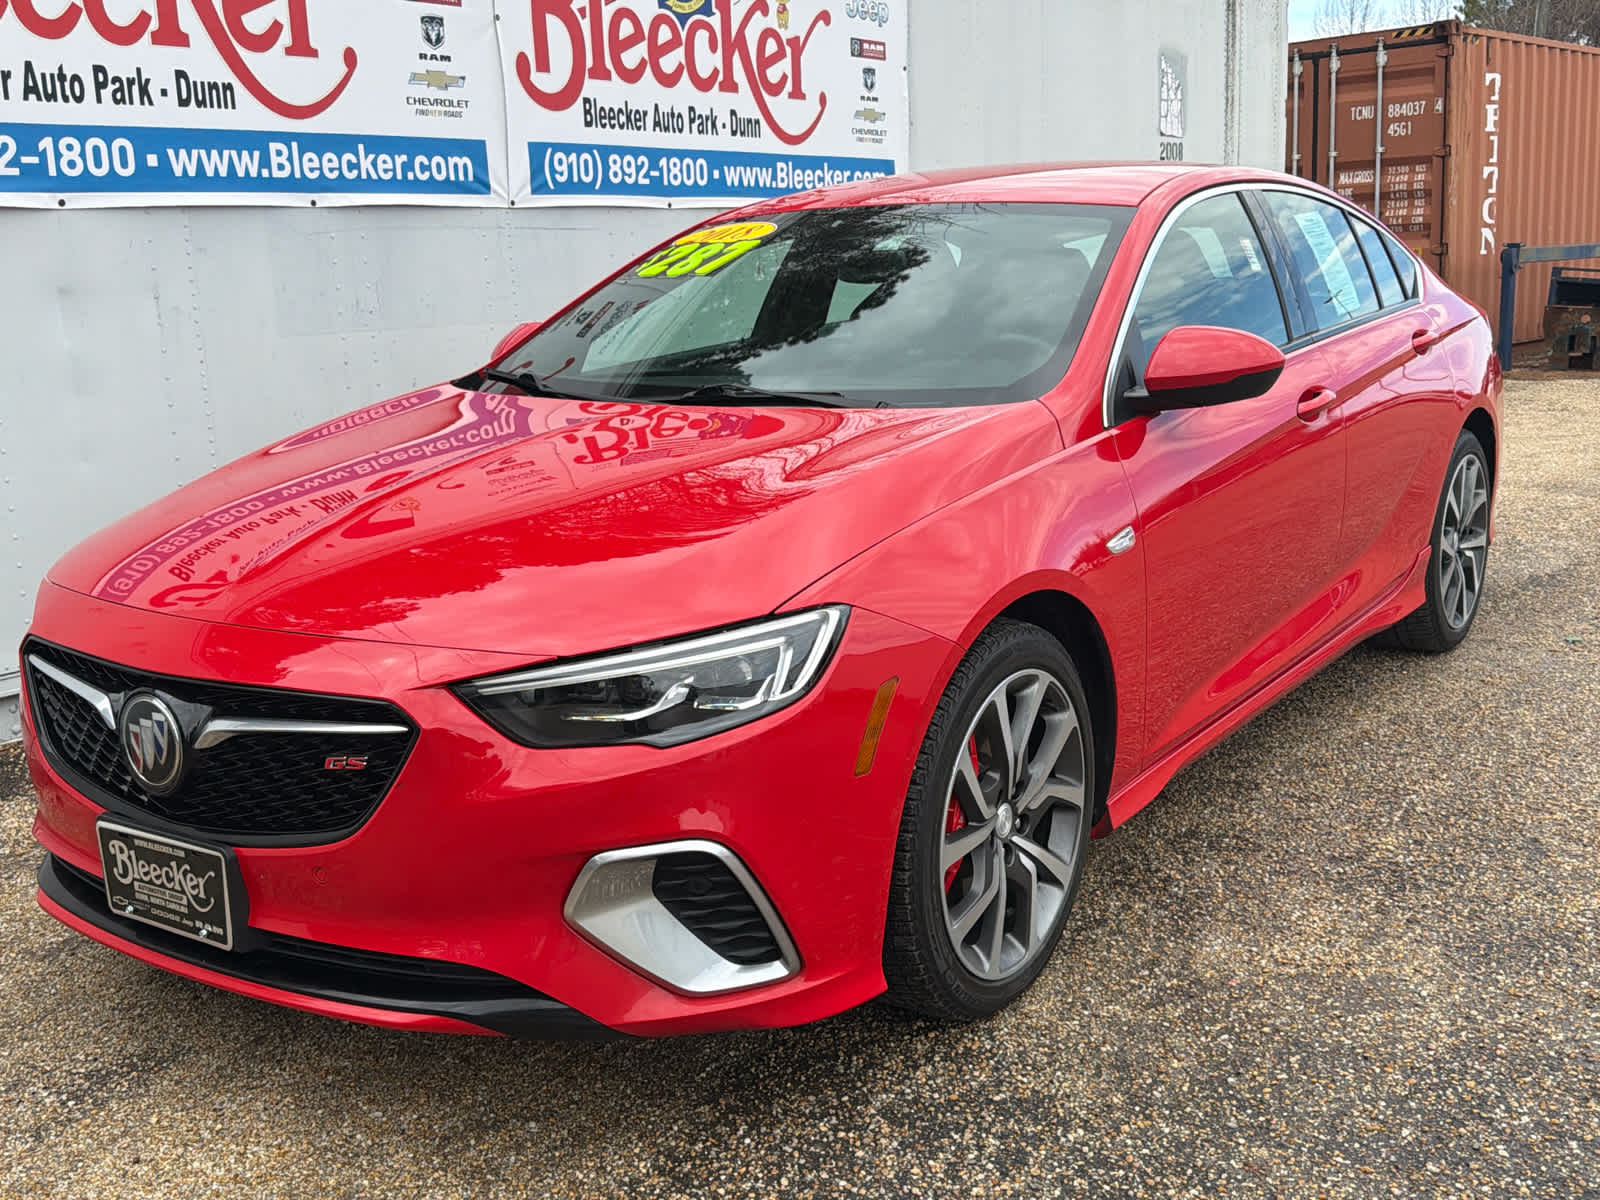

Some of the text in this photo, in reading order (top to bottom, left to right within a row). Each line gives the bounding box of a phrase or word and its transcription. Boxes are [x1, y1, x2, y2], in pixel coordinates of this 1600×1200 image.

[418, 52, 452, 63] RAM
[23, 60, 85, 104] Auto
[92, 64, 154, 106] Park
[174, 69, 237, 110] Dunn
[405, 96, 471, 109] CHEVROLET
[582, 96, 762, 138] Bleecker Auto Park Dunn
[1350, 97, 1444, 120] TCNU 884037 4
[1387, 120, 1412, 136] 45G1
[166, 141, 475, 182] www.Bleecker.com
[544, 147, 886, 190] (910) 892-1800 www.Bleecker
[324, 755, 369, 771] GS
[108, 839, 216, 913] Bleecker
